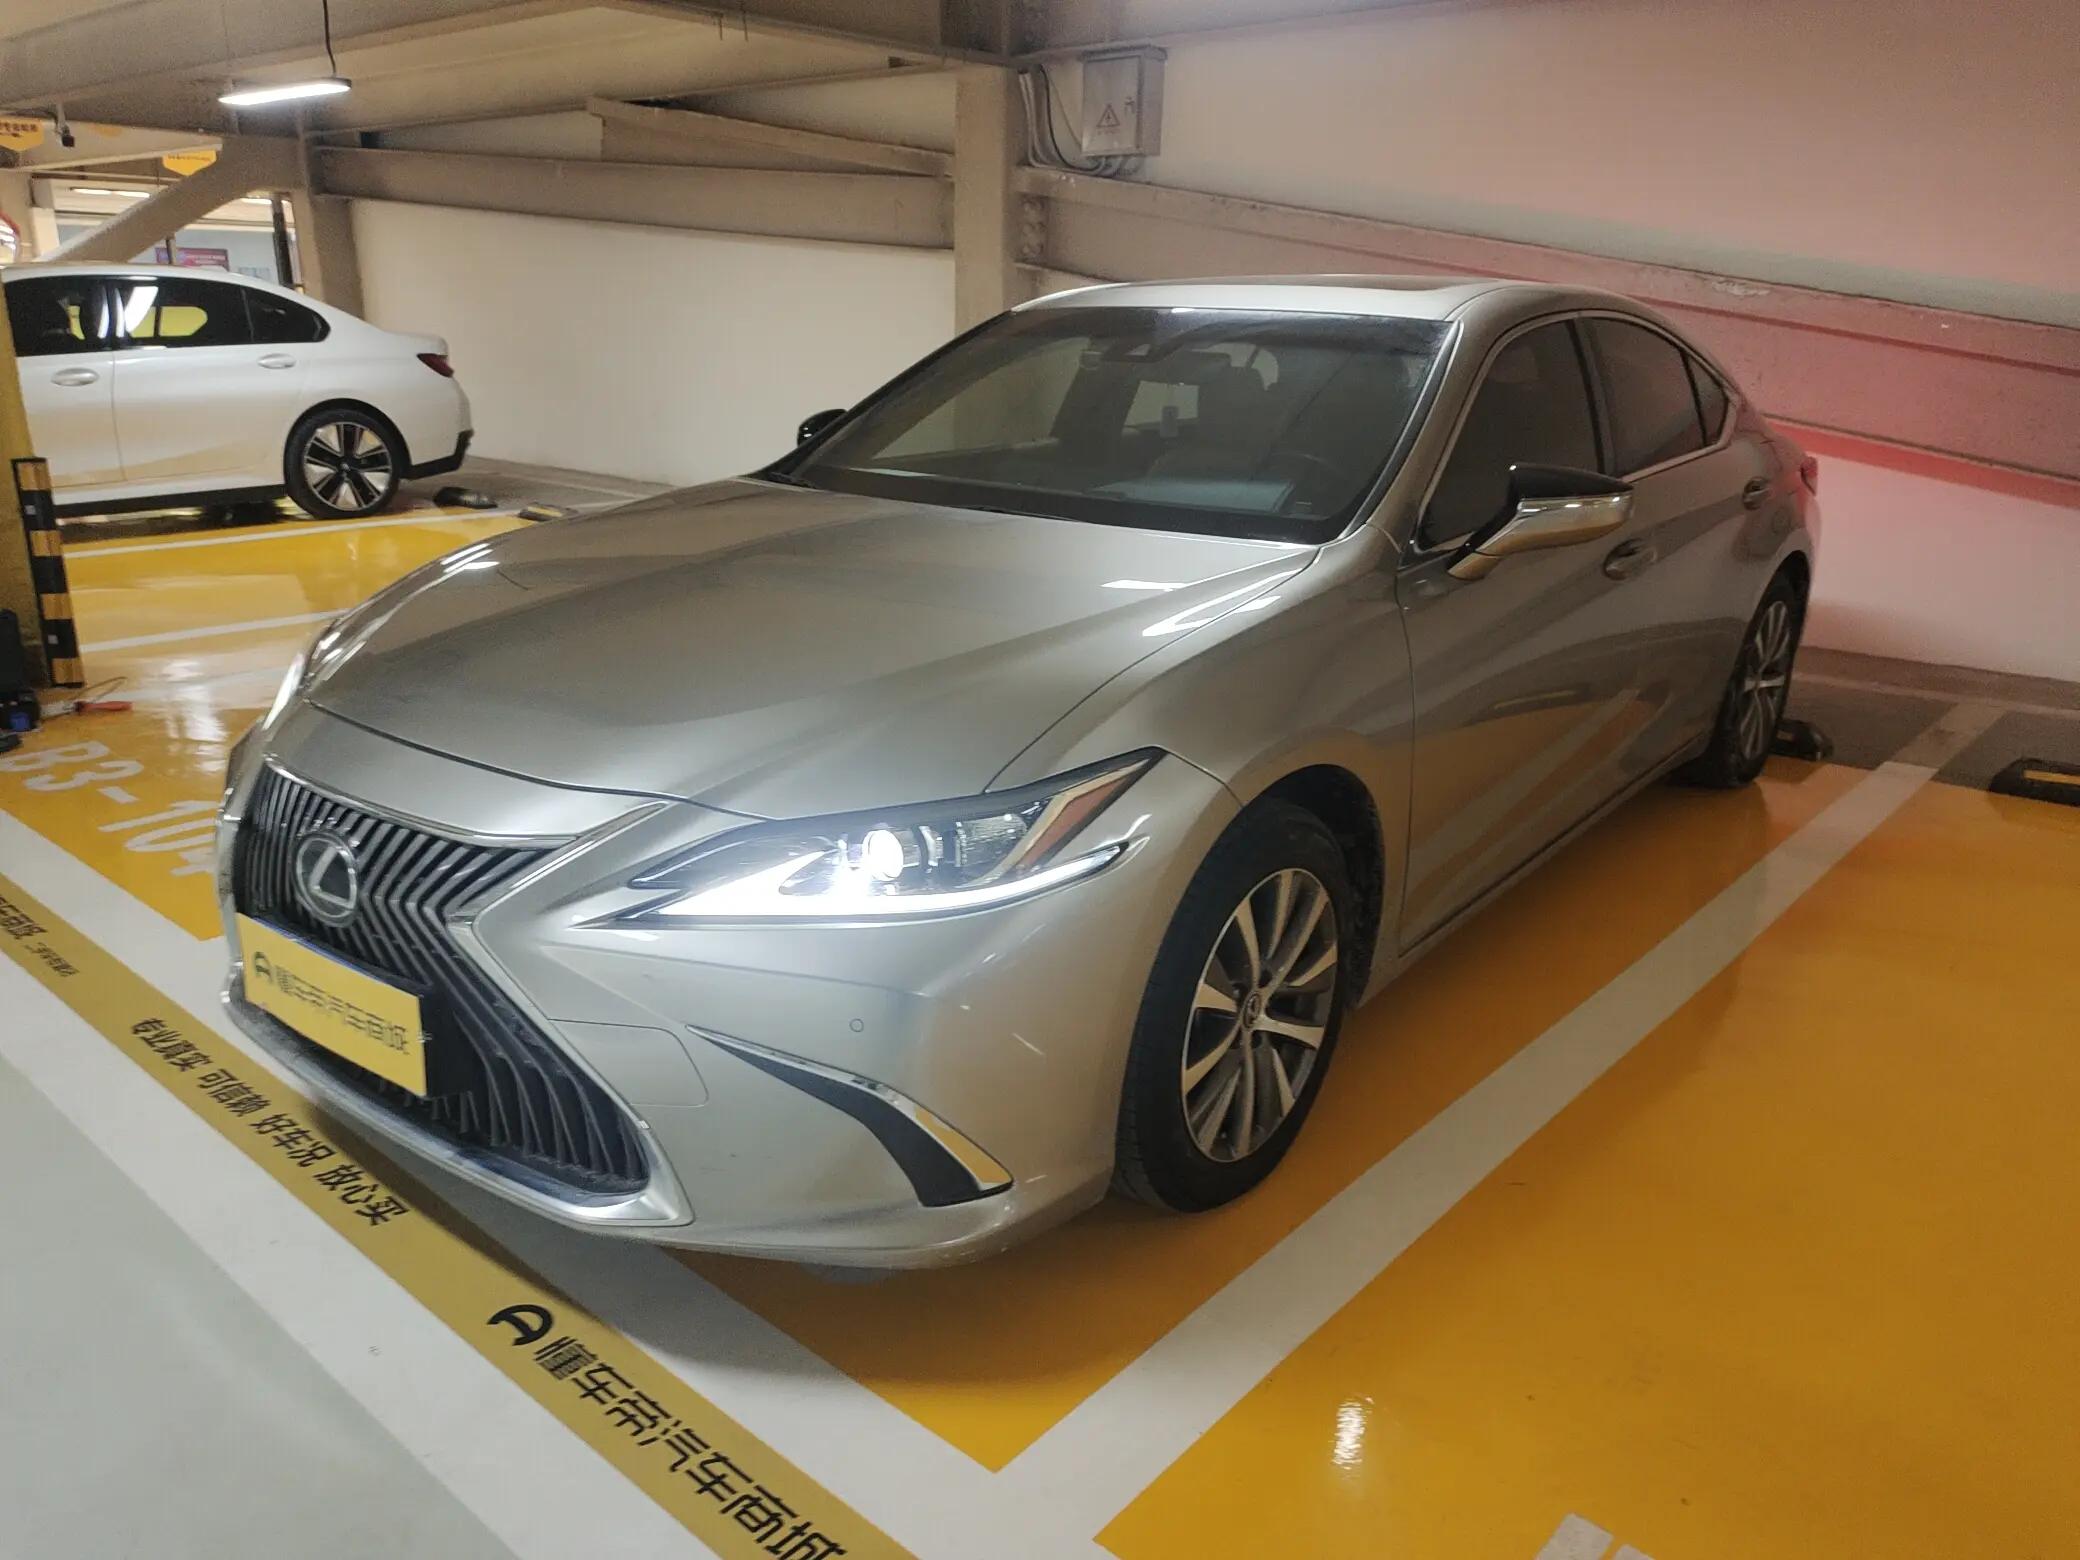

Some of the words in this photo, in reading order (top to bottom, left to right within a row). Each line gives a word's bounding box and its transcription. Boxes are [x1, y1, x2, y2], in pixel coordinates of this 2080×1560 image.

[132, 1017, 214, 1072] 专业真实
[198, 1068, 272, 1117] 可信赖
[249, 1112, 338, 1168] 好车况
[312, 1163, 410, 1226] 放心买
